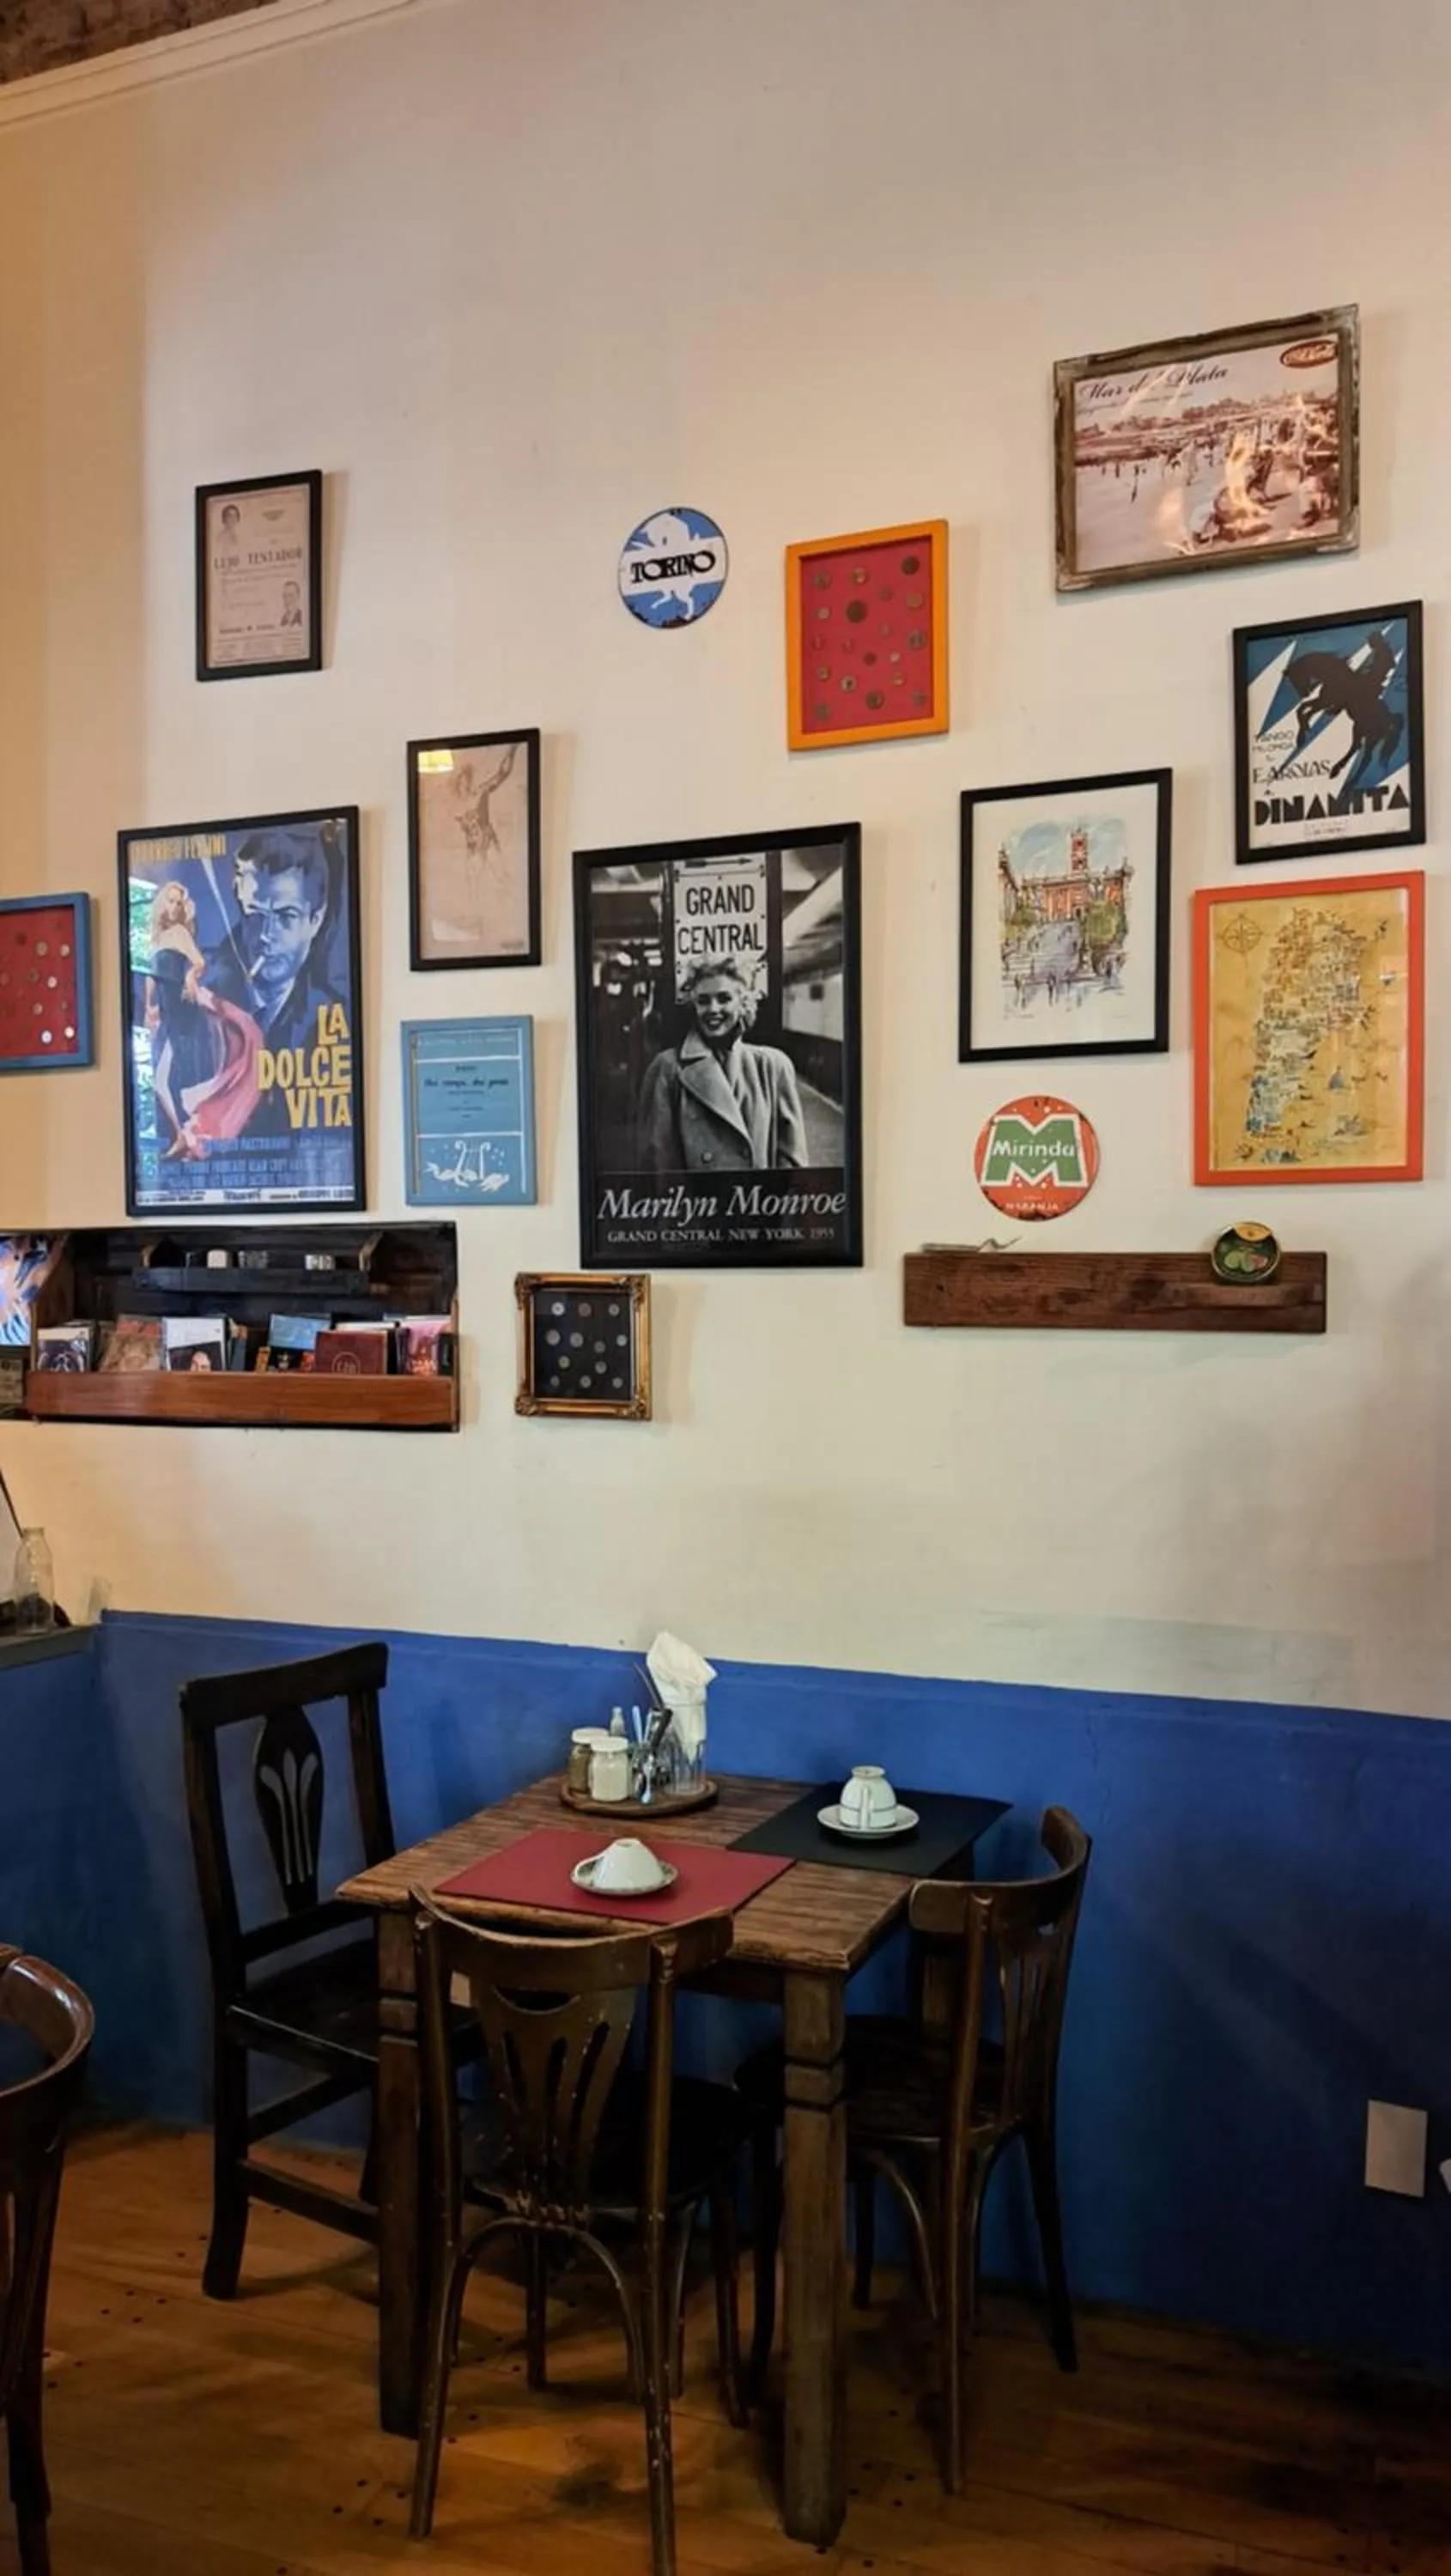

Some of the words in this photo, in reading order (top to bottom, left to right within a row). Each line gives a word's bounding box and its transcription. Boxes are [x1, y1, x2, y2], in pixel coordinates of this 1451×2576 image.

[630, 550, 716, 584] TORINO
[1254, 783, 1410, 826] DINAMITA
[686, 884, 755, 916] GRAND
[677, 922, 764, 955] CENTRAL
[319, 1003, 349, 1045] LA
[258, 1045, 352, 1091] DOLCE
[285, 1085, 353, 1129] VITA
[993, 1139, 1074, 1156] Mirinda
[597, 1186, 718, 1227] Marilyn
[726, 1185, 847, 1216] Monroe
[608, 1230, 658, 1243] GRAND
[660, 1229, 722, 1242] CENTRAL
[728, 1228, 761, 1241] NEW
[765, 1227, 804, 1239] YORK
